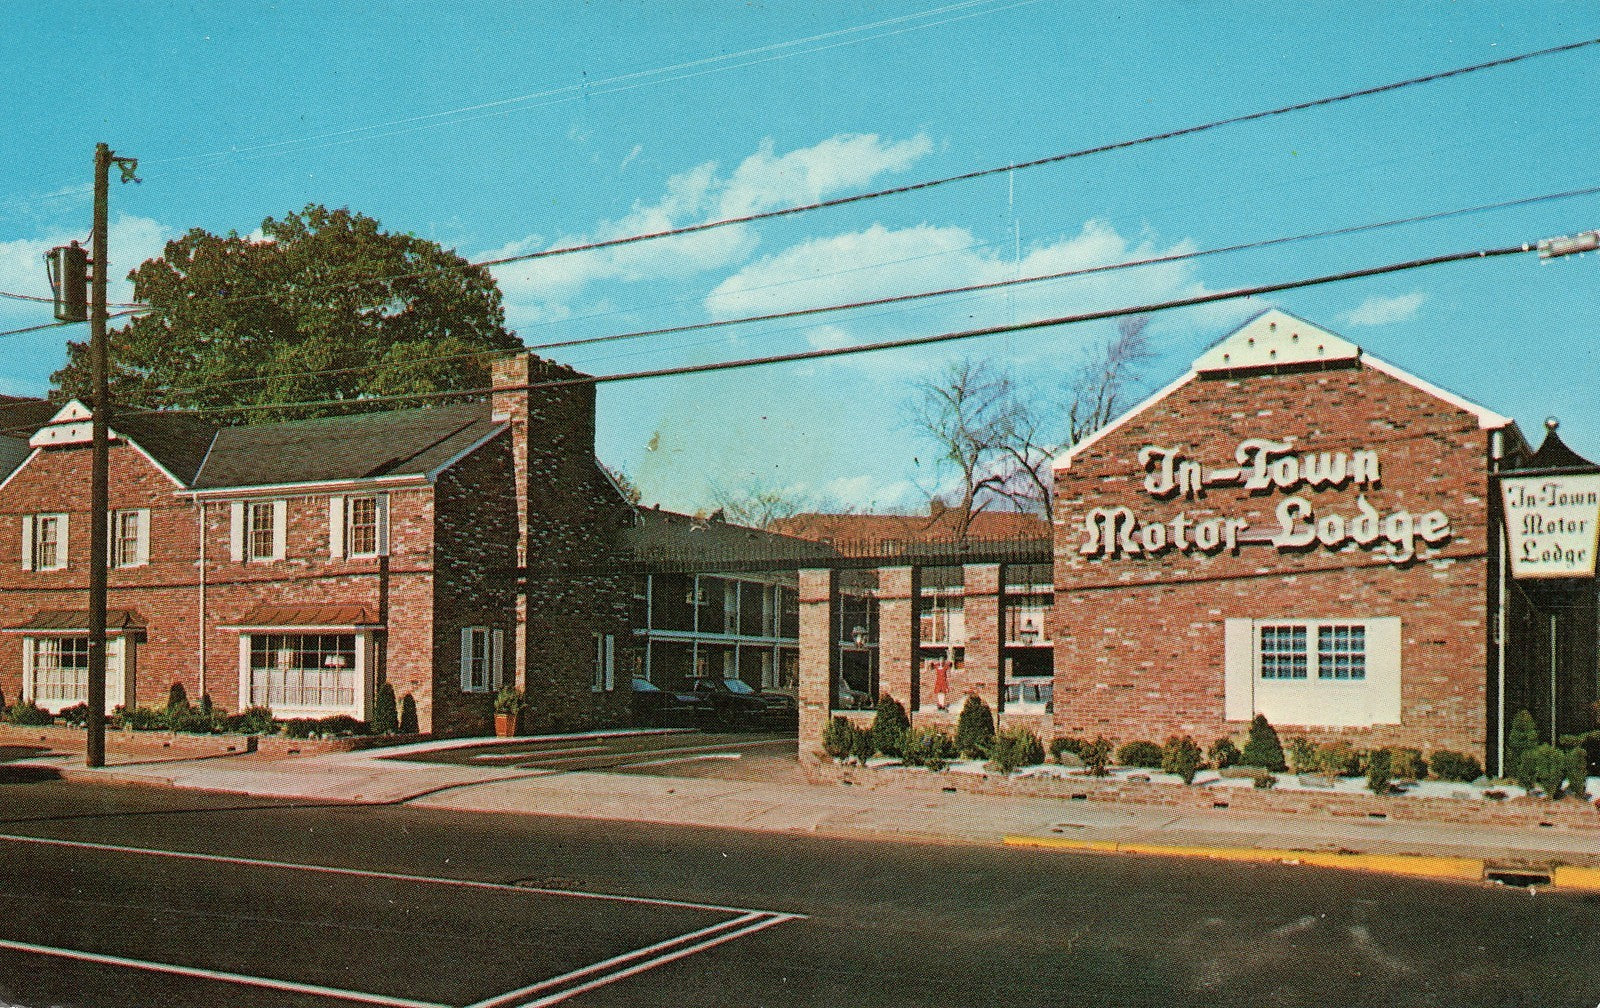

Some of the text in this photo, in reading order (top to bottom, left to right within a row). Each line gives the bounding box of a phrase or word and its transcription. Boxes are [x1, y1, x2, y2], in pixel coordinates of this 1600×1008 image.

[1138, 438, 1381, 499] In-Town
[1508, 483, 1597, 507] In-Town
[1080, 494, 1453, 564] Motor Lodge
[1522, 513, 1588, 534] Motor
[1520, 540, 1586, 568] Lodge
